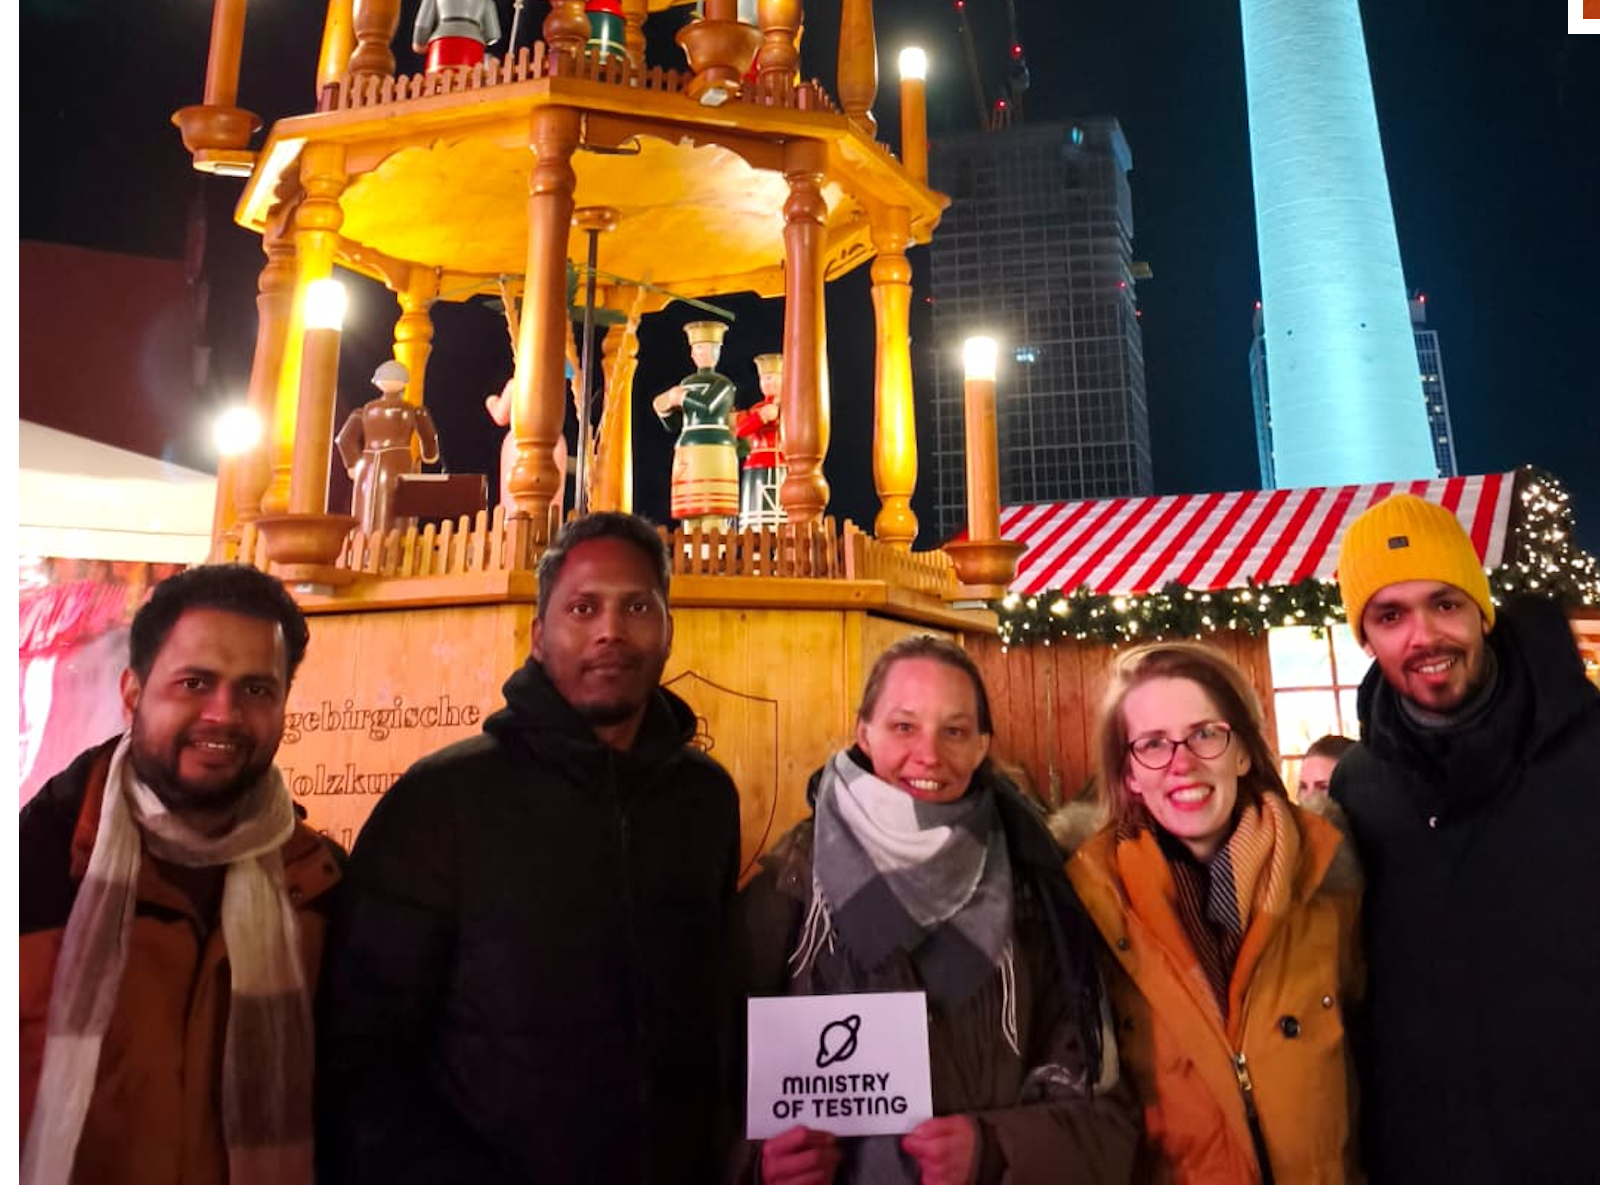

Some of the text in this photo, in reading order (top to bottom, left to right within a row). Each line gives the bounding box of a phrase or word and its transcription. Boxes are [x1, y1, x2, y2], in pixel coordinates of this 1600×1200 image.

[281, 694, 481, 744] gebirgische
[782, 1072, 890, 1095] MINISTRY
[772, 1096, 908, 1119] OF TESTING
